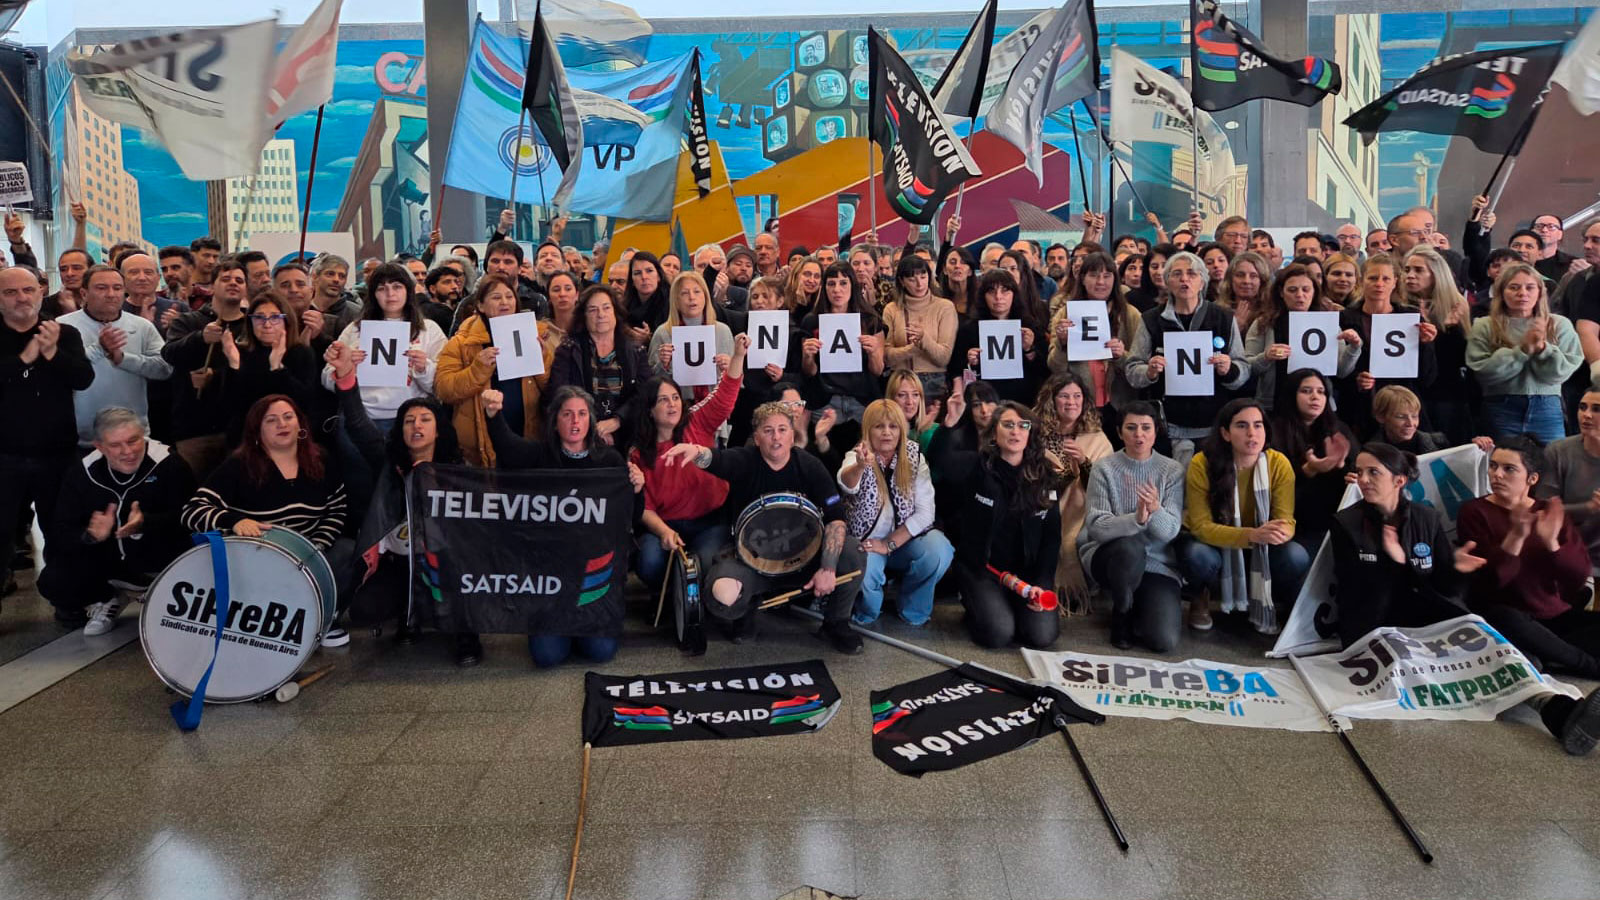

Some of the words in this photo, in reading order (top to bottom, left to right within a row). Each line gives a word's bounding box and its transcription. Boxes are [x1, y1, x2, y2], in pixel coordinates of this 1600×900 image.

[758, 325, 779, 350] N
[830, 329, 853, 354] A
[1082, 316, 1099, 341] E
[1302, 328, 1327, 356] O
[371, 337, 397, 366] N
[513, 330, 523, 358] I
[684, 342, 705, 367] U
[987, 335, 1015, 361] M
[1384, 330, 1406, 358] S
[1177, 348, 1202, 375] N
[427, 489, 607, 524] TELEVISIÓN
[461, 573, 562, 595] SATSAID
[160, 618, 197, 634] Sindicato
[199, 627, 209, 636] de
[238, 636, 248, 645] de
[249, 638, 278, 653] Buenos
[1430, 661, 1472, 674] Prensa
[1477, 655, 1491, 665] de
[1062, 659, 1280, 698] SiPreBA
[1412, 662, 1529, 707] FATPREN
